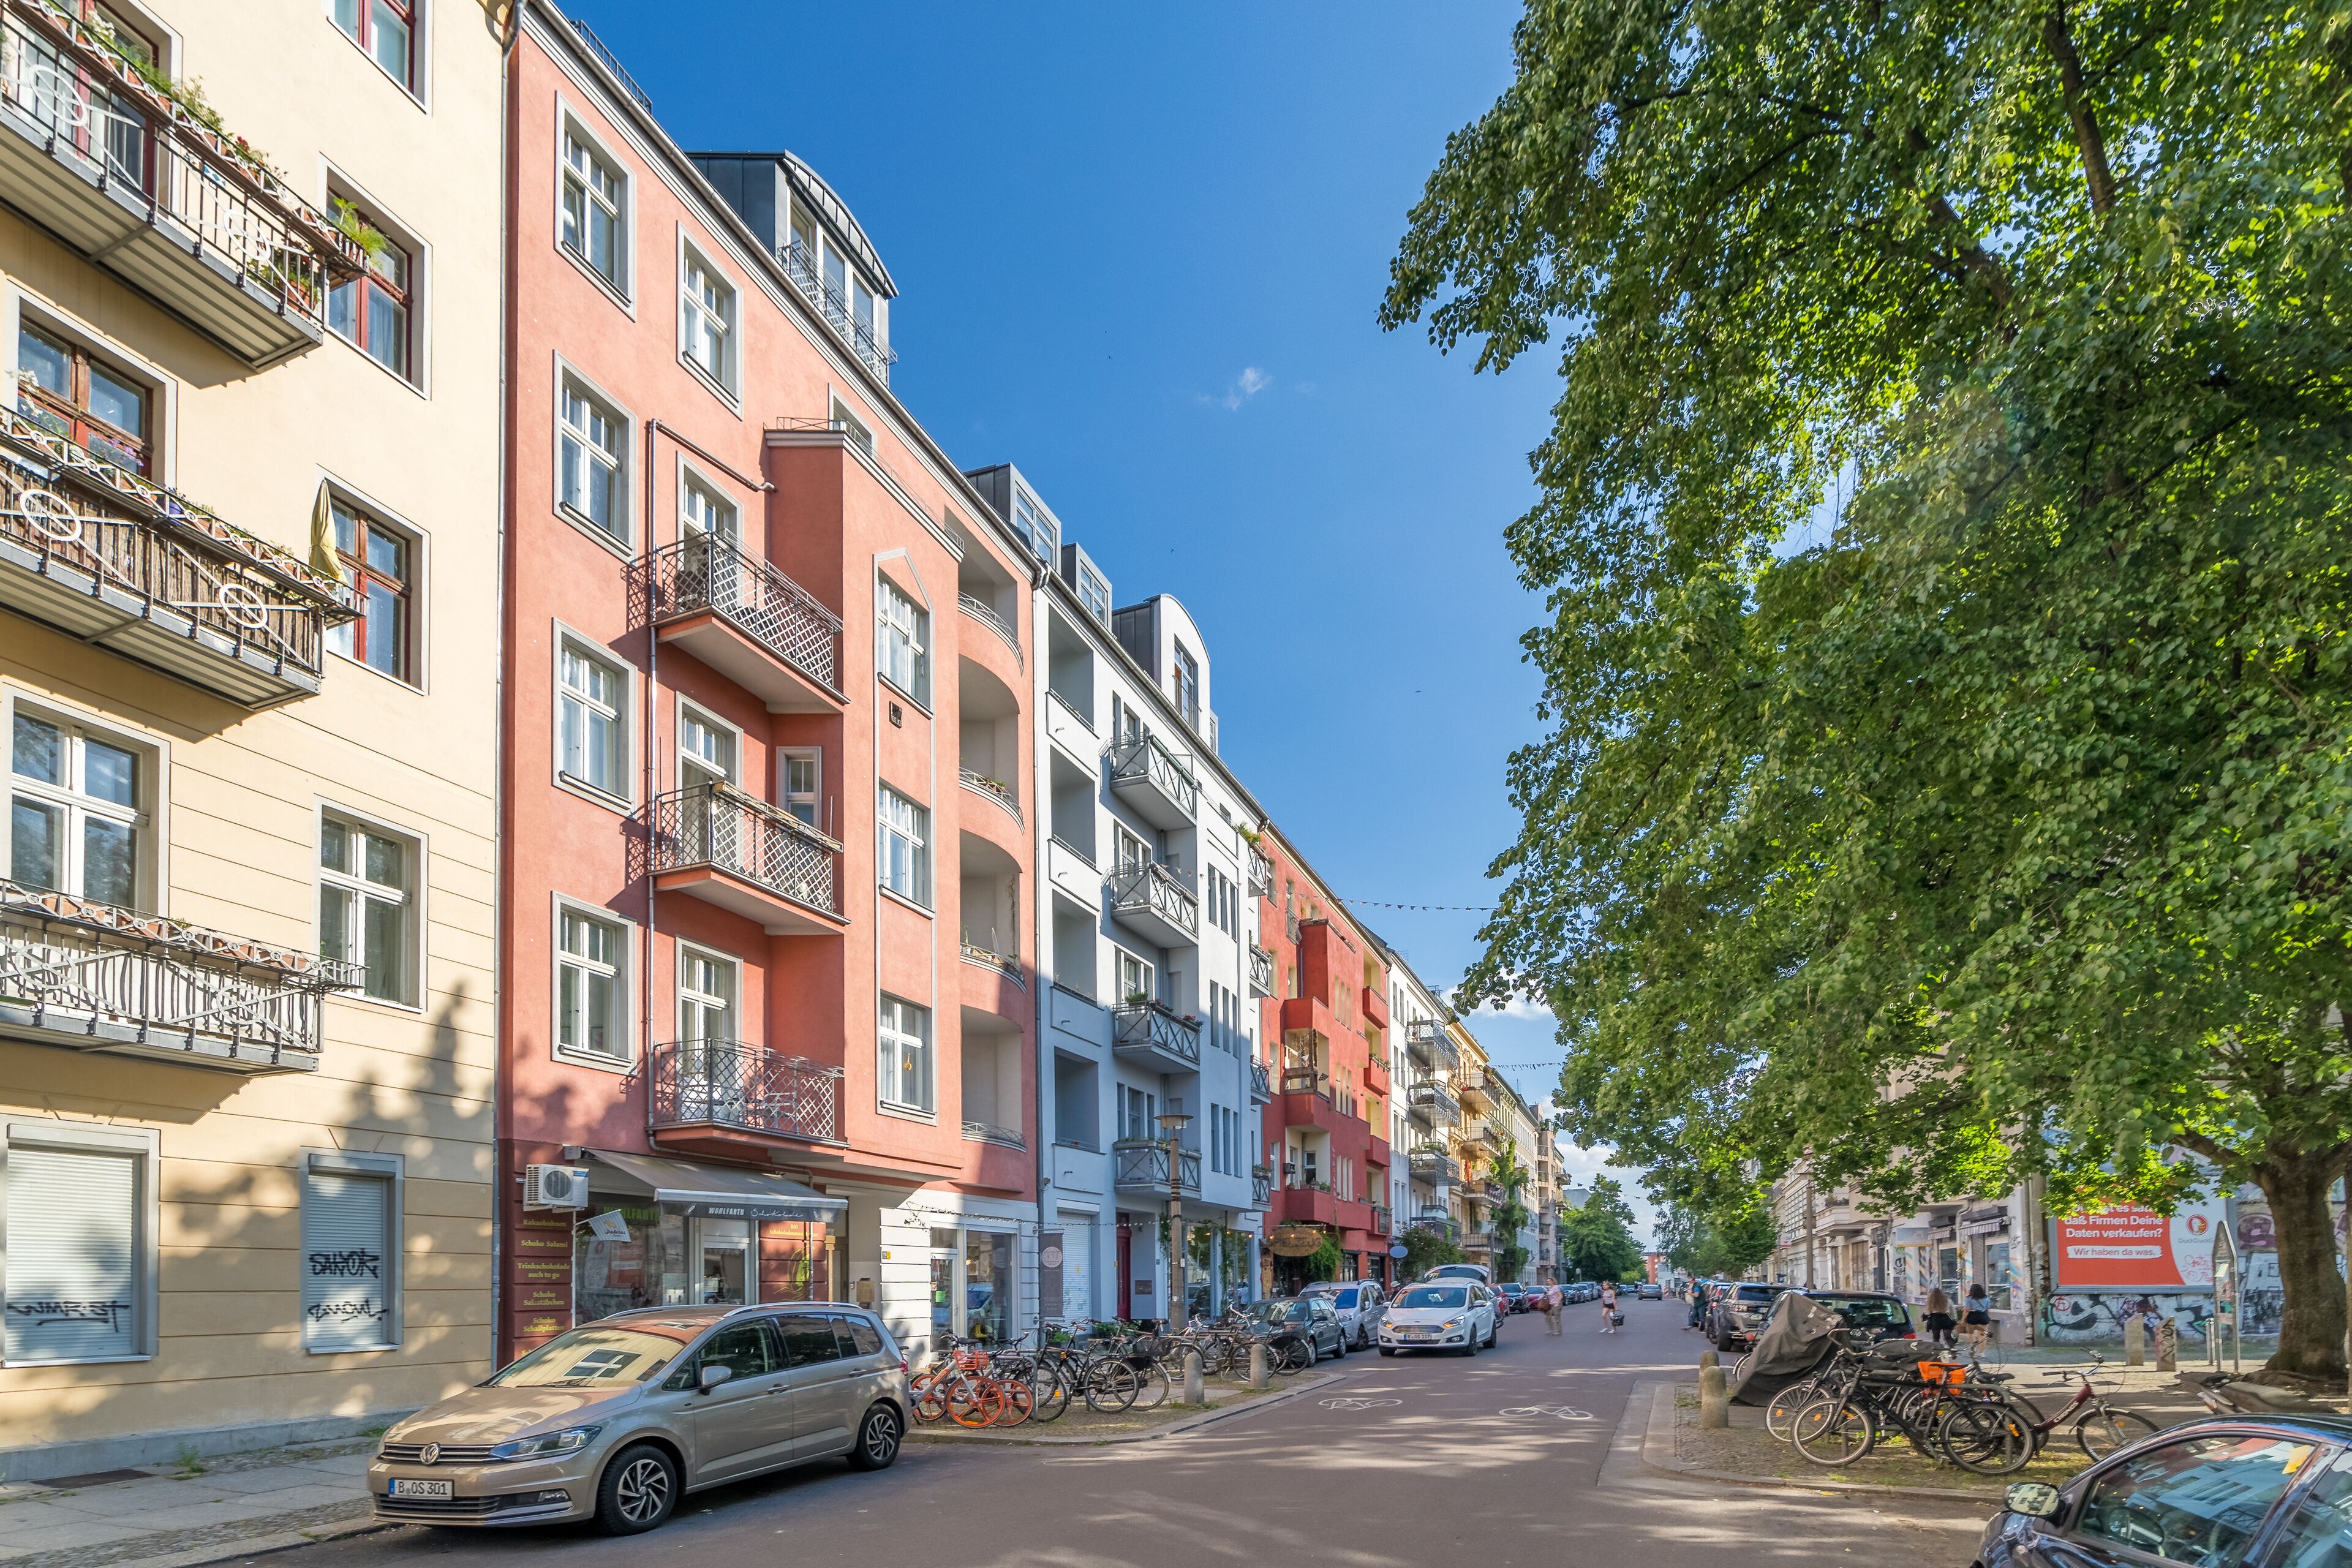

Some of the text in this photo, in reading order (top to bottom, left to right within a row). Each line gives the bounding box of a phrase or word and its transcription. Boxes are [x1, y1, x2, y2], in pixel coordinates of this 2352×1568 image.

[708, 1207, 745, 1216] WOHLFARTH
[522, 1219, 567, 1227] Kakaobohnen
[2089, 1215, 2128, 1226] Firmen
[2130, 1215, 2164, 1226] Deine
[2065, 1228, 2163, 1238] Daten verkaufen?
[2073, 1248, 2089, 1256] Wir
[2091, 1248, 2120, 1256] haben
[2121, 1248, 2133, 1256] da
[522, 1324, 565, 1333] Schallplatten
[398, 1481, 405, 1493] B
[427, 1482, 448, 1495] 301
